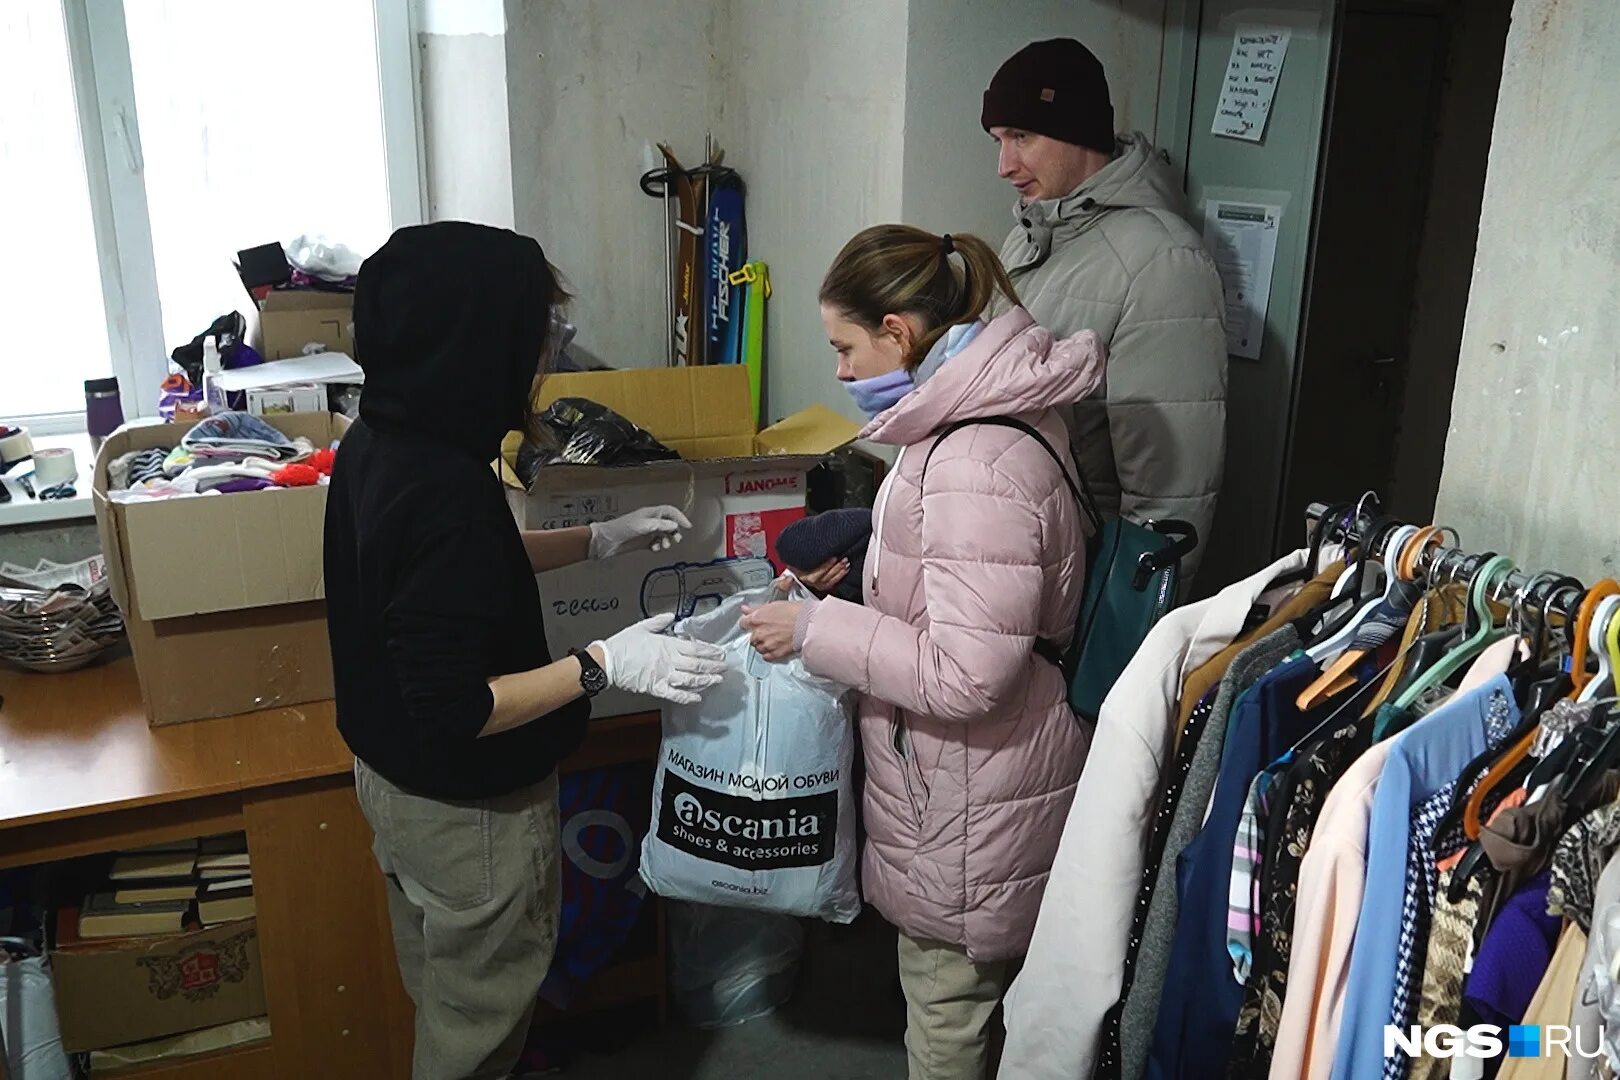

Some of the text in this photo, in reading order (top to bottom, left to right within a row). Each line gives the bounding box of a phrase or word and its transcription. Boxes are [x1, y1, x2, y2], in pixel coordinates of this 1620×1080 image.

[717, 221, 731, 322] FISCHER
[667, 748, 725, 784] МАГАЗИН
[793, 769, 840, 789] ОБУВИ
[673, 791, 820, 841] ascania
[672, 824, 819, 861] shoes & accessories
[711, 879, 768, 896] ascania.biz
